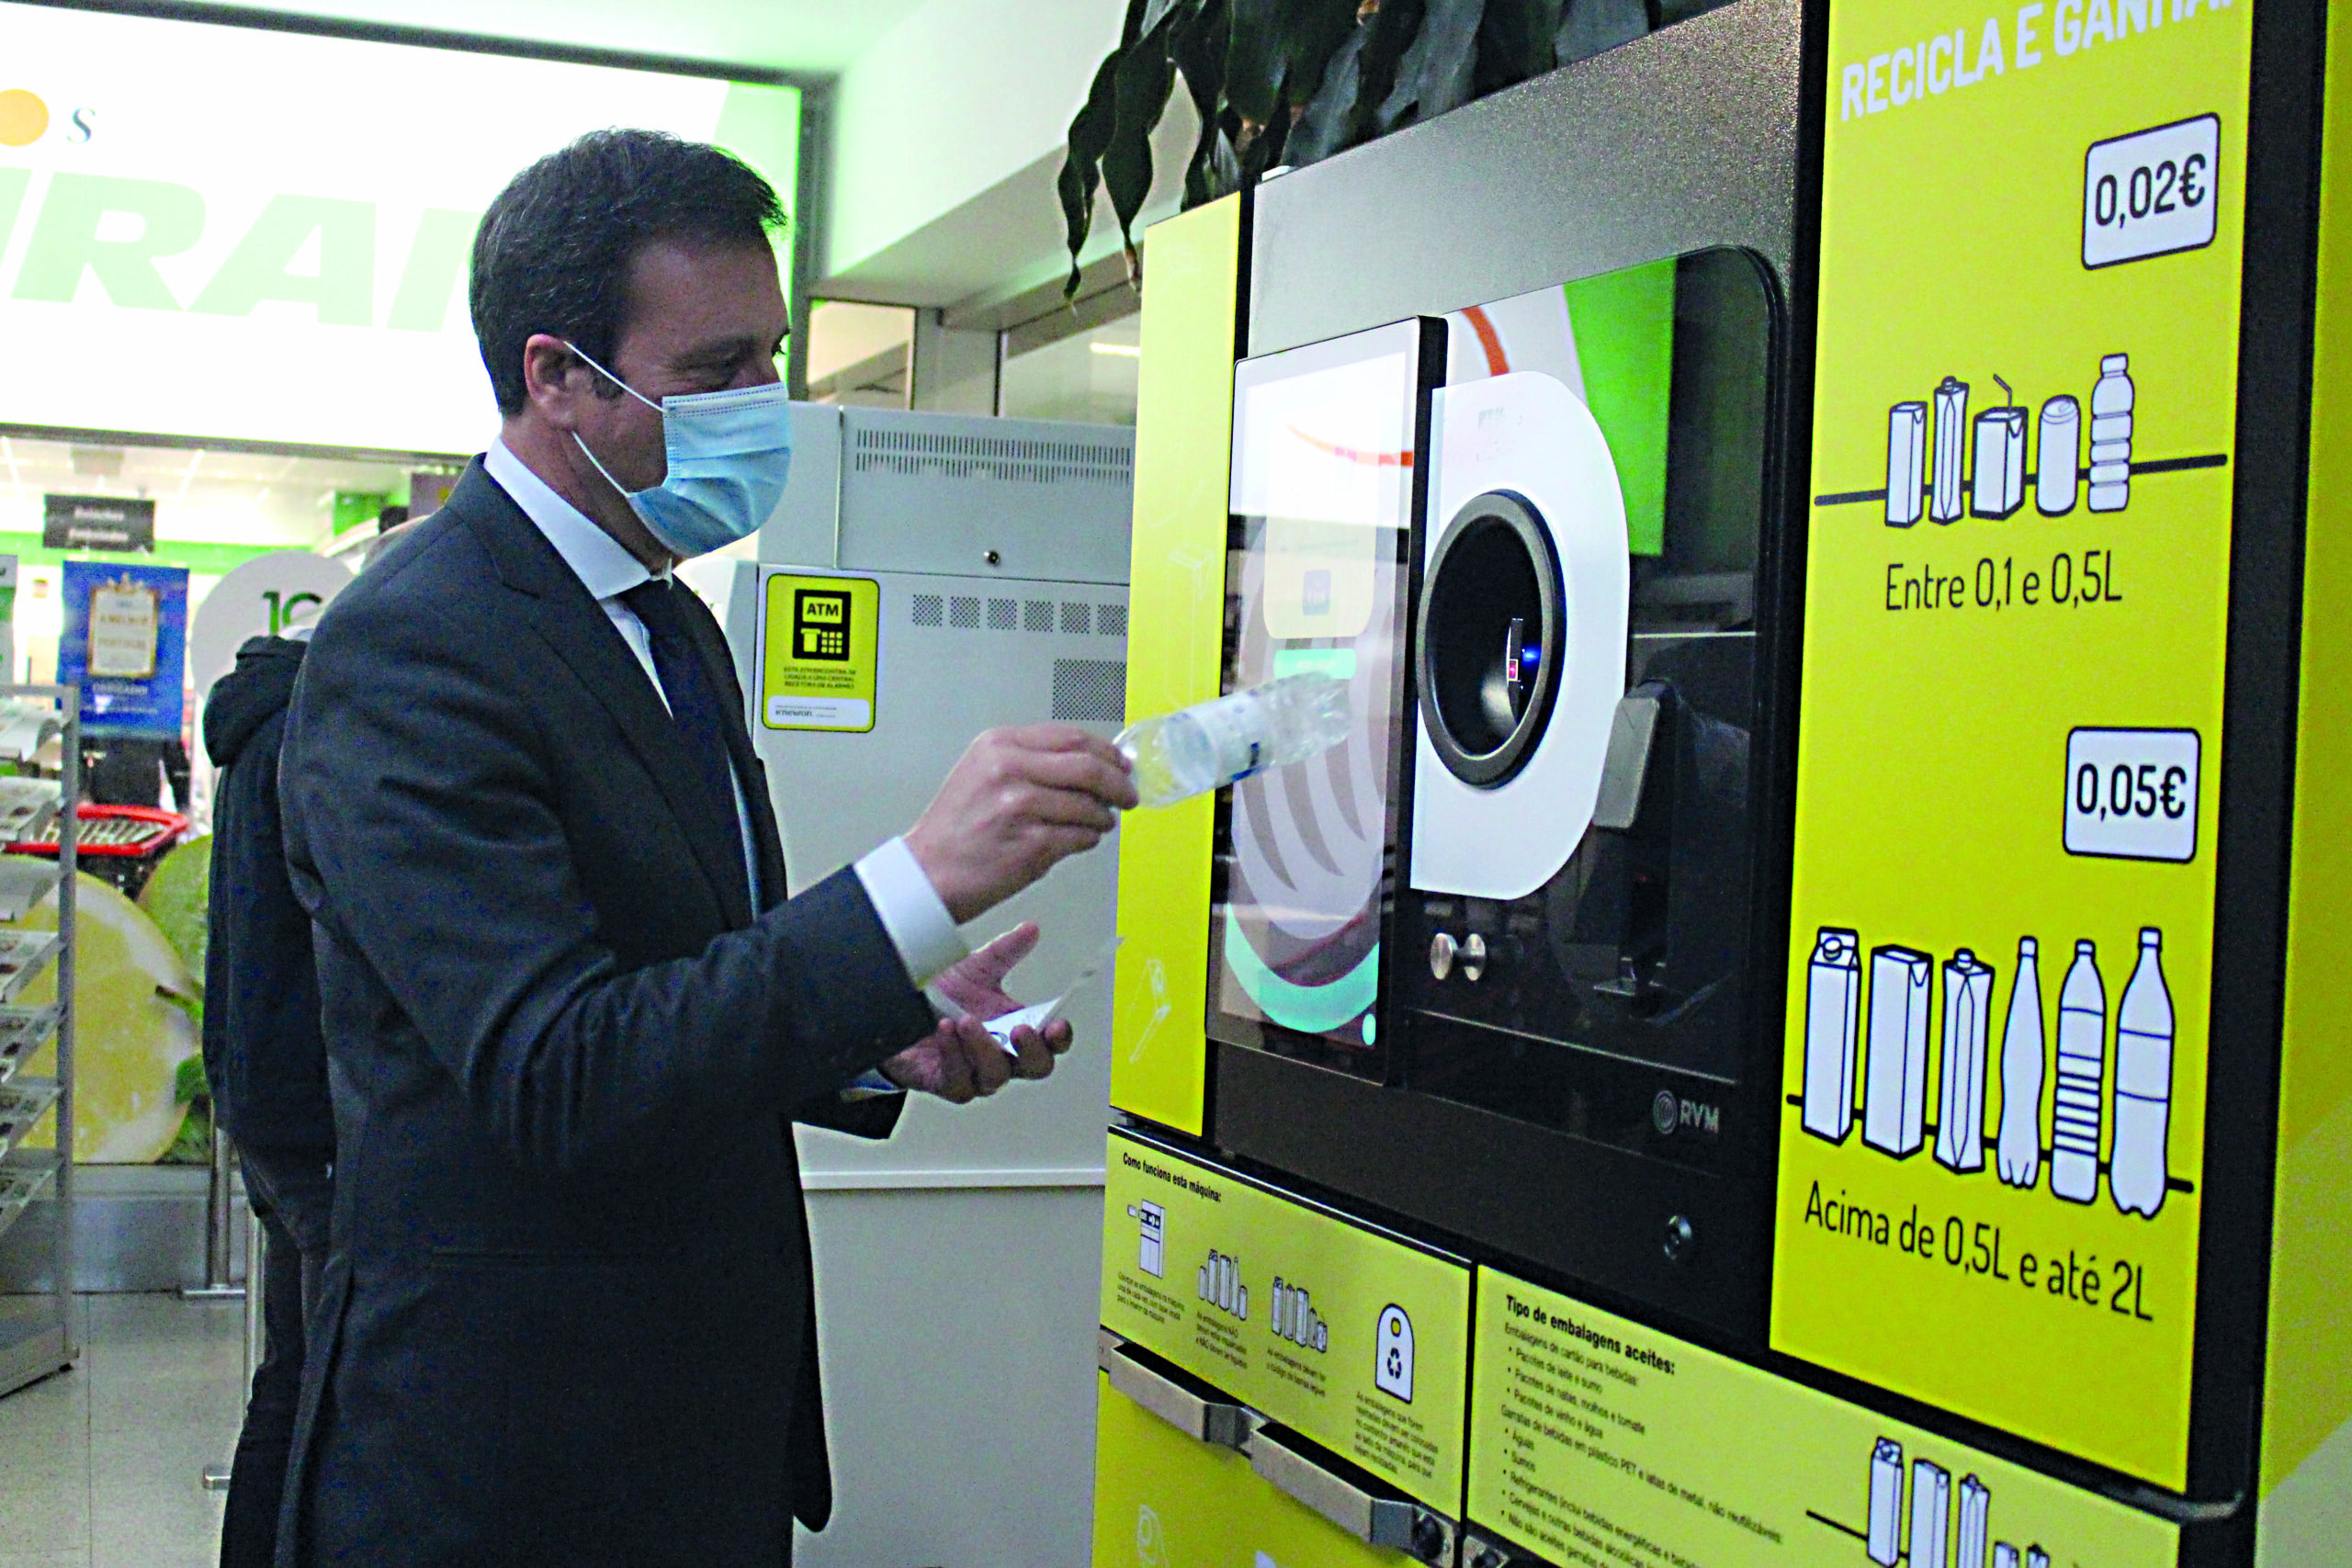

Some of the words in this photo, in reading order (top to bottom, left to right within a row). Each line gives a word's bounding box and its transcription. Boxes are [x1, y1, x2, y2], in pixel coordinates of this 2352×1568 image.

[1840, 17, 2005, 121] RECICLA
[2017, 3, 2042, 69] E
[2096, 153, 2206, 229] 0,02€
[807, 603, 839, 616] ATM
[1886, 563, 1965, 610] Entre
[1975, 557, 2012, 611] 0,1
[2022, 571, 2040, 605] e
[2052, 550, 2122, 608] 0,5L
[2076, 763, 2187, 821] 0,05€
[1680, 1100, 1719, 1134] RVM
[1123, 1152, 1141, 1170] Como
[1143, 1160, 1171, 1182] funciona
[1172, 1174, 1187, 1189] esta
[1189, 1180, 1221, 1202] máquina:
[1804, 1180, 1889, 1246] Acima
[1900, 1204, 1934, 1258] de
[1944, 1216, 2009, 1280] 0,5L
[2021, 1253, 2037, 1287] e
[2047, 1250, 2100, 1305] até
[2111, 1260, 2153, 1321] 2L
[1506, 1293, 1530, 1318] Tipo
[1533, 1306, 1547, 1325] de
[1550, 1315, 1621, 1354] embalagens
[1624, 1344, 1676, 1376] aceites:
